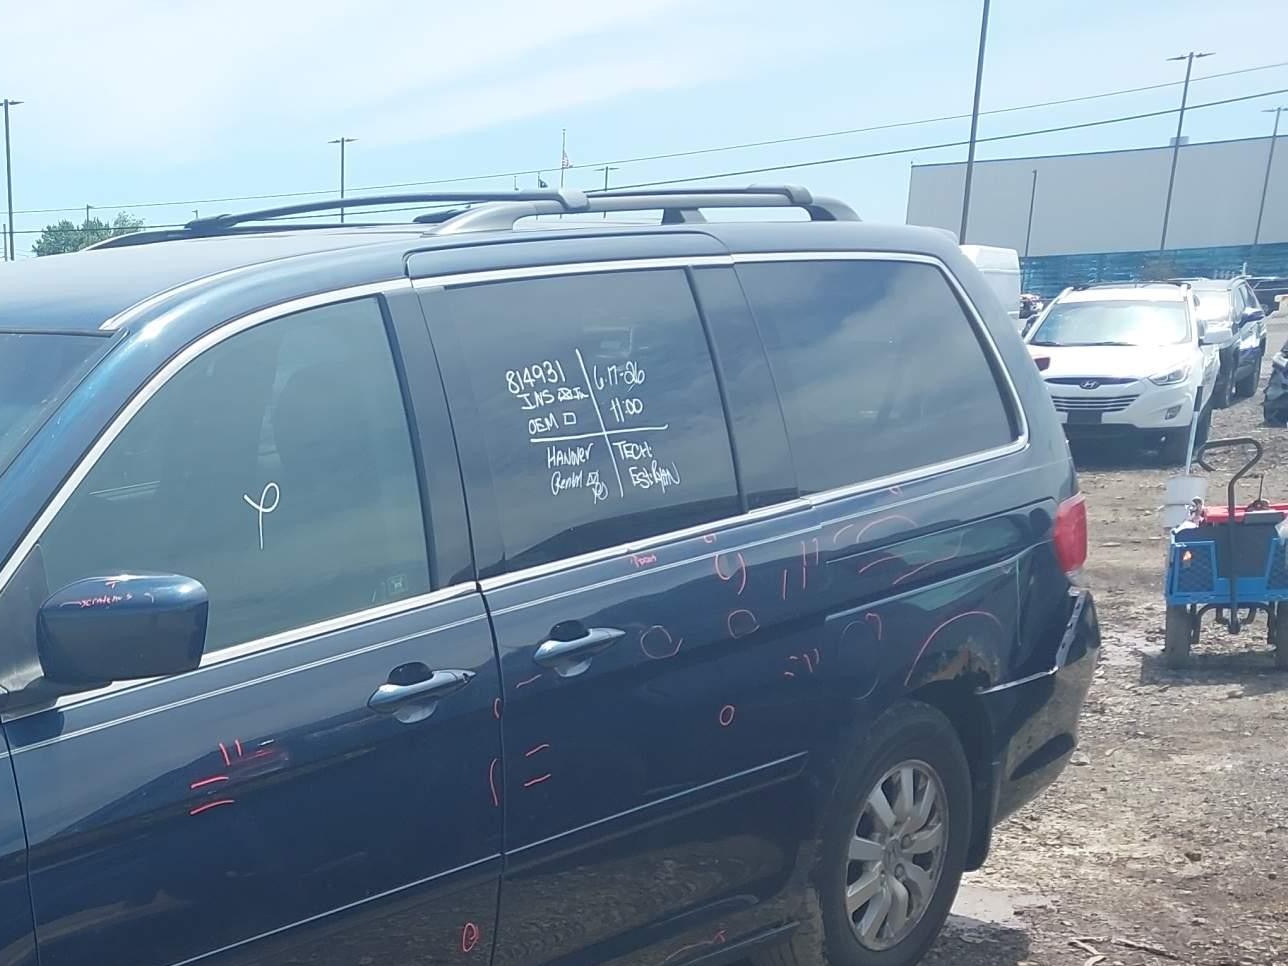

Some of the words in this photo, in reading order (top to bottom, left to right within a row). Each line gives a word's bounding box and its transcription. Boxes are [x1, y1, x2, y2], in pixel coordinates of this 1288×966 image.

[505, 360, 566, 394] 814931
[516, 389, 555, 410] INS
[609, 397, 643, 422] 11:00
[528, 412, 559, 435] OEM
